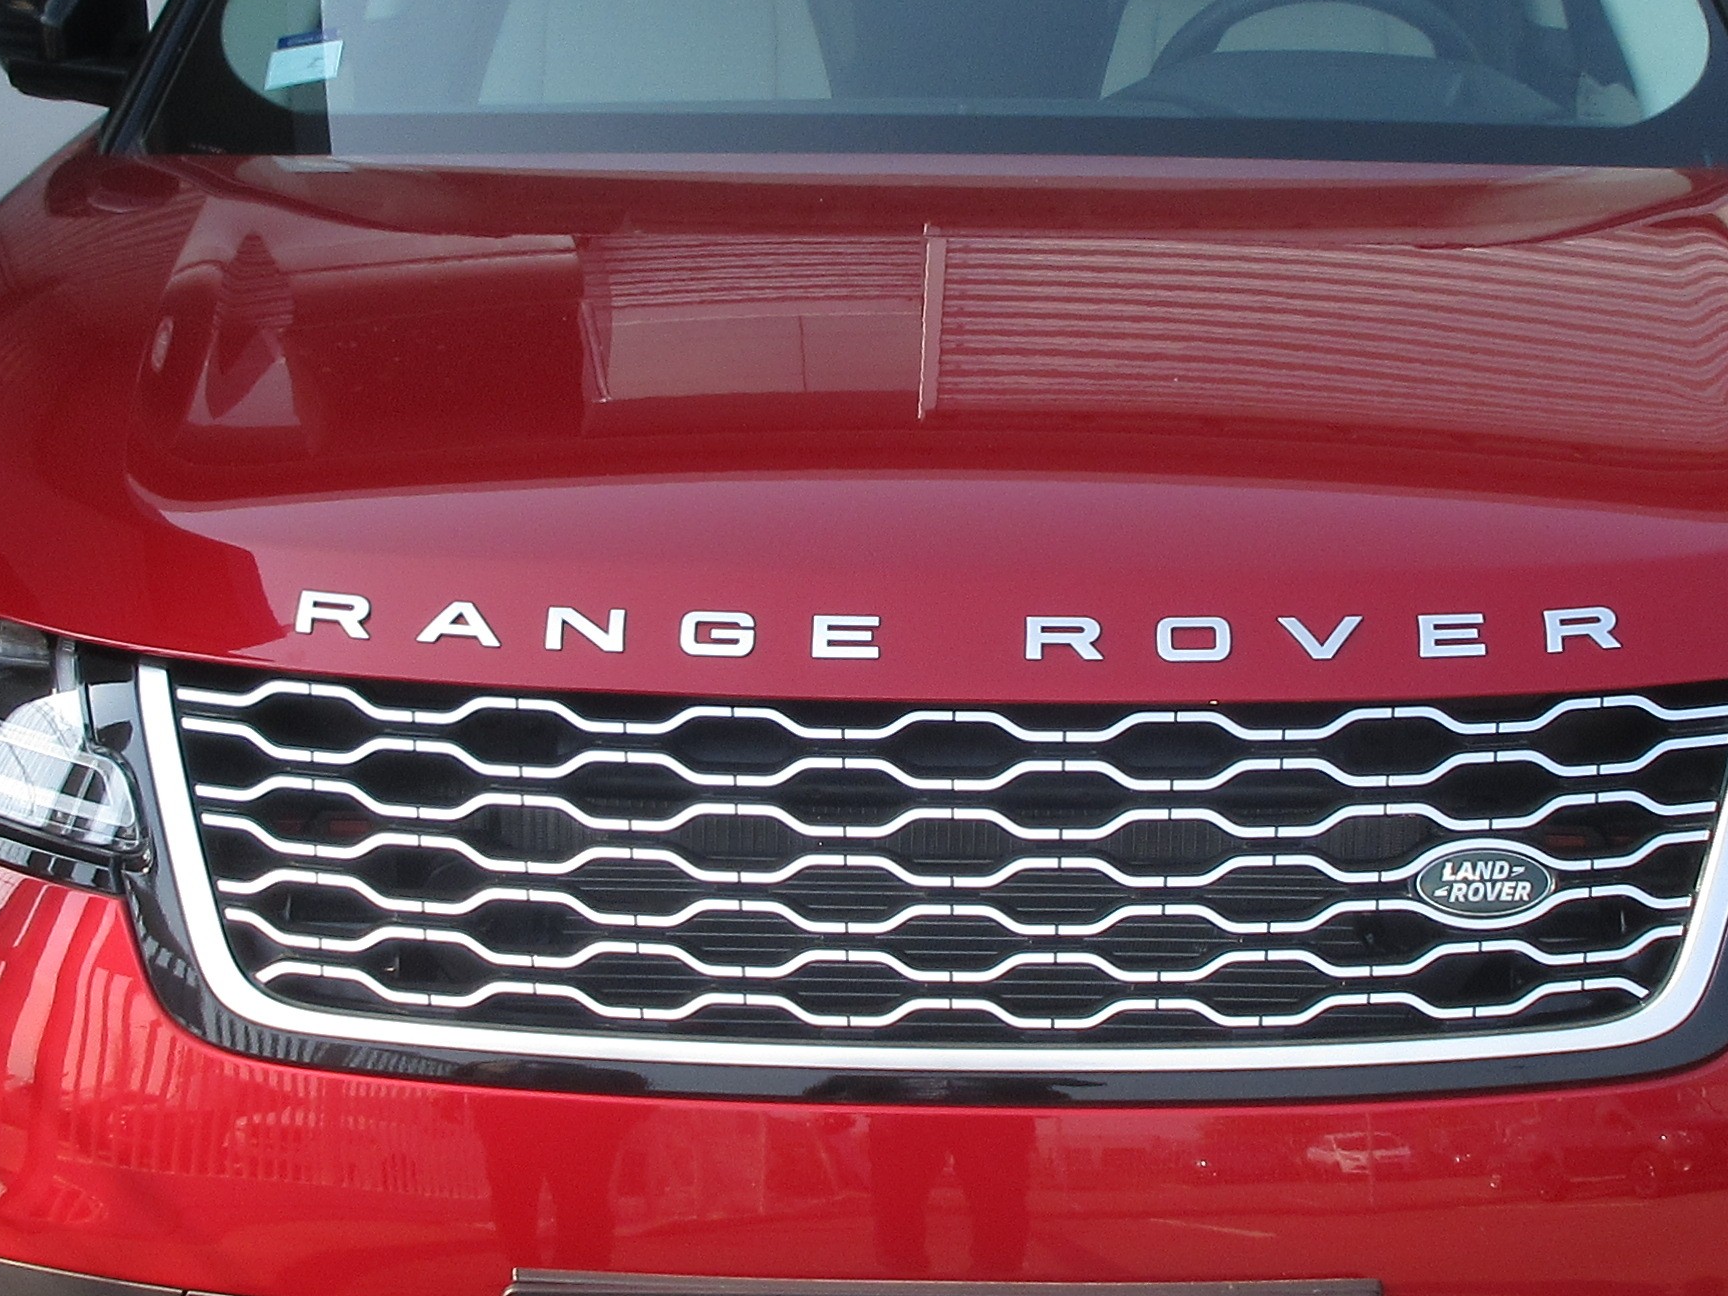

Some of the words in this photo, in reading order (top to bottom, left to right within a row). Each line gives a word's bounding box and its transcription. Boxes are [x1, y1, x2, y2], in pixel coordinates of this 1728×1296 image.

[293, 590, 881, 661] RANGE
[1025, 605, 1625, 663] ROVER
[1441, 861, 1510, 882] LAND
[1448, 881, 1532, 903] ROVER
